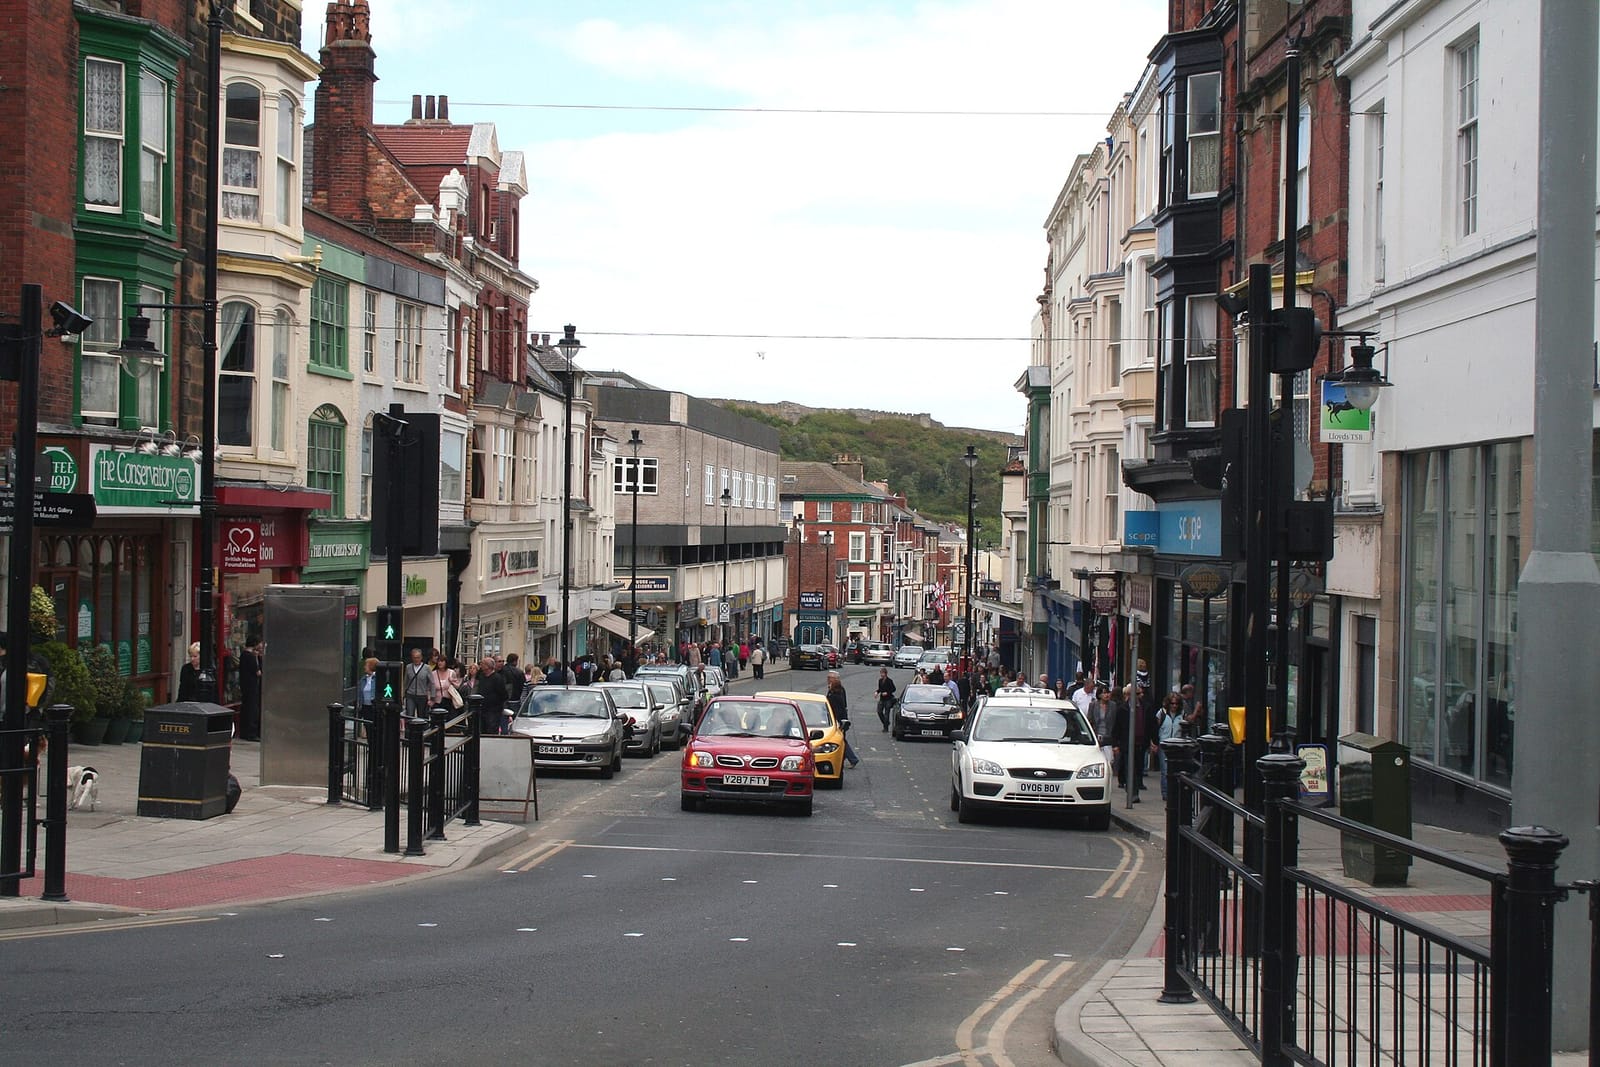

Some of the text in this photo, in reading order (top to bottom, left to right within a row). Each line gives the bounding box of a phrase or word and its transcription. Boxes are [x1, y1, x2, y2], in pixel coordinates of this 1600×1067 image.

[1328, 433, 1349, 441] Lloyds
[100, 451, 175, 490] the Conservatory
[260, 522, 275, 536] eart
[1128, 532, 1156, 542] scope
[322, 544, 347, 557] KITCHEN
[348, 543, 362, 556] SHOP
[160, 724, 190, 733] LITTER
[725, 775, 767, 785] Y287 FTY
[1020, 783, 1042, 792] OY06
